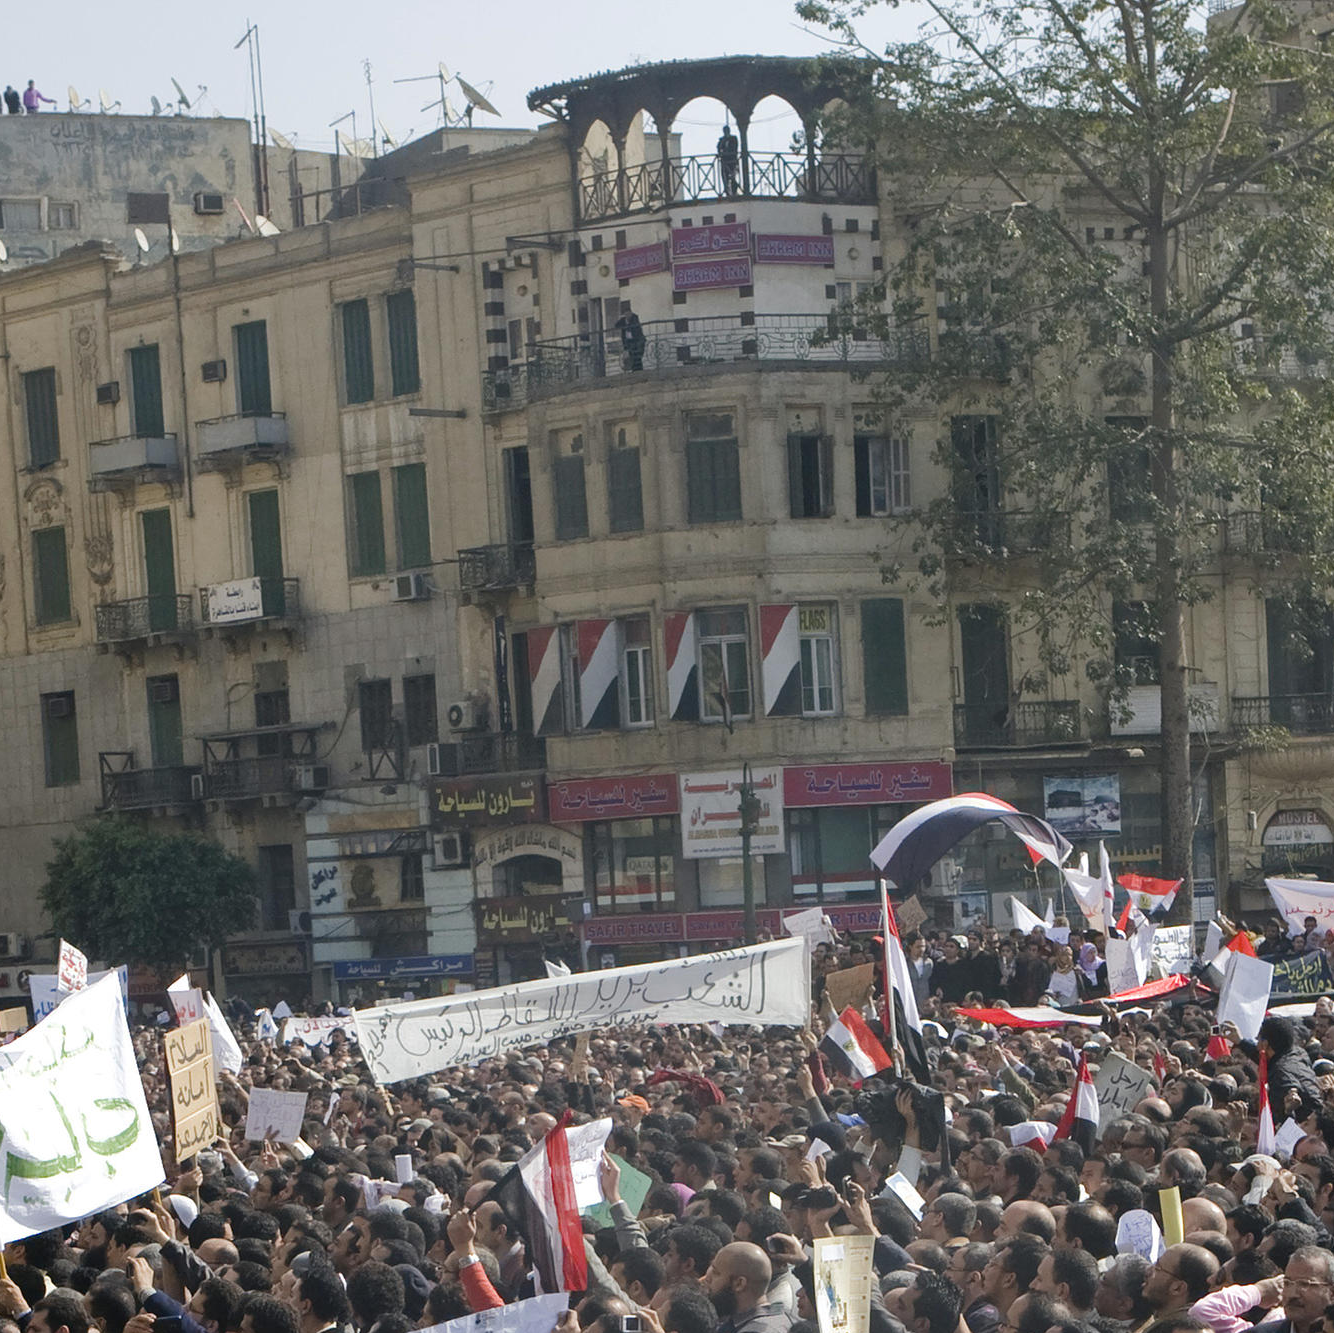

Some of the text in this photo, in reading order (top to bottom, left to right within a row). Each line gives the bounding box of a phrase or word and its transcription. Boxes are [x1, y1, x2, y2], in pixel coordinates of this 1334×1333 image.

[805, 770, 882, 798] للسياحة
[437, 787, 535, 817] بارون للسياحة
[560, 785, 625, 813] للسياحة
[1278, 811, 1319, 824] HOSTEL
[482, 904, 528, 935] للسياحة
[588, 921, 679, 938] SAFIR TRAVEL
[347, 959, 463, 976] مراكش للسياحة
[644, 951, 766, 1015] الشعب
[169, 1022, 208, 1068] السلام
[1110, 1065, 1145, 1093] ارحل
